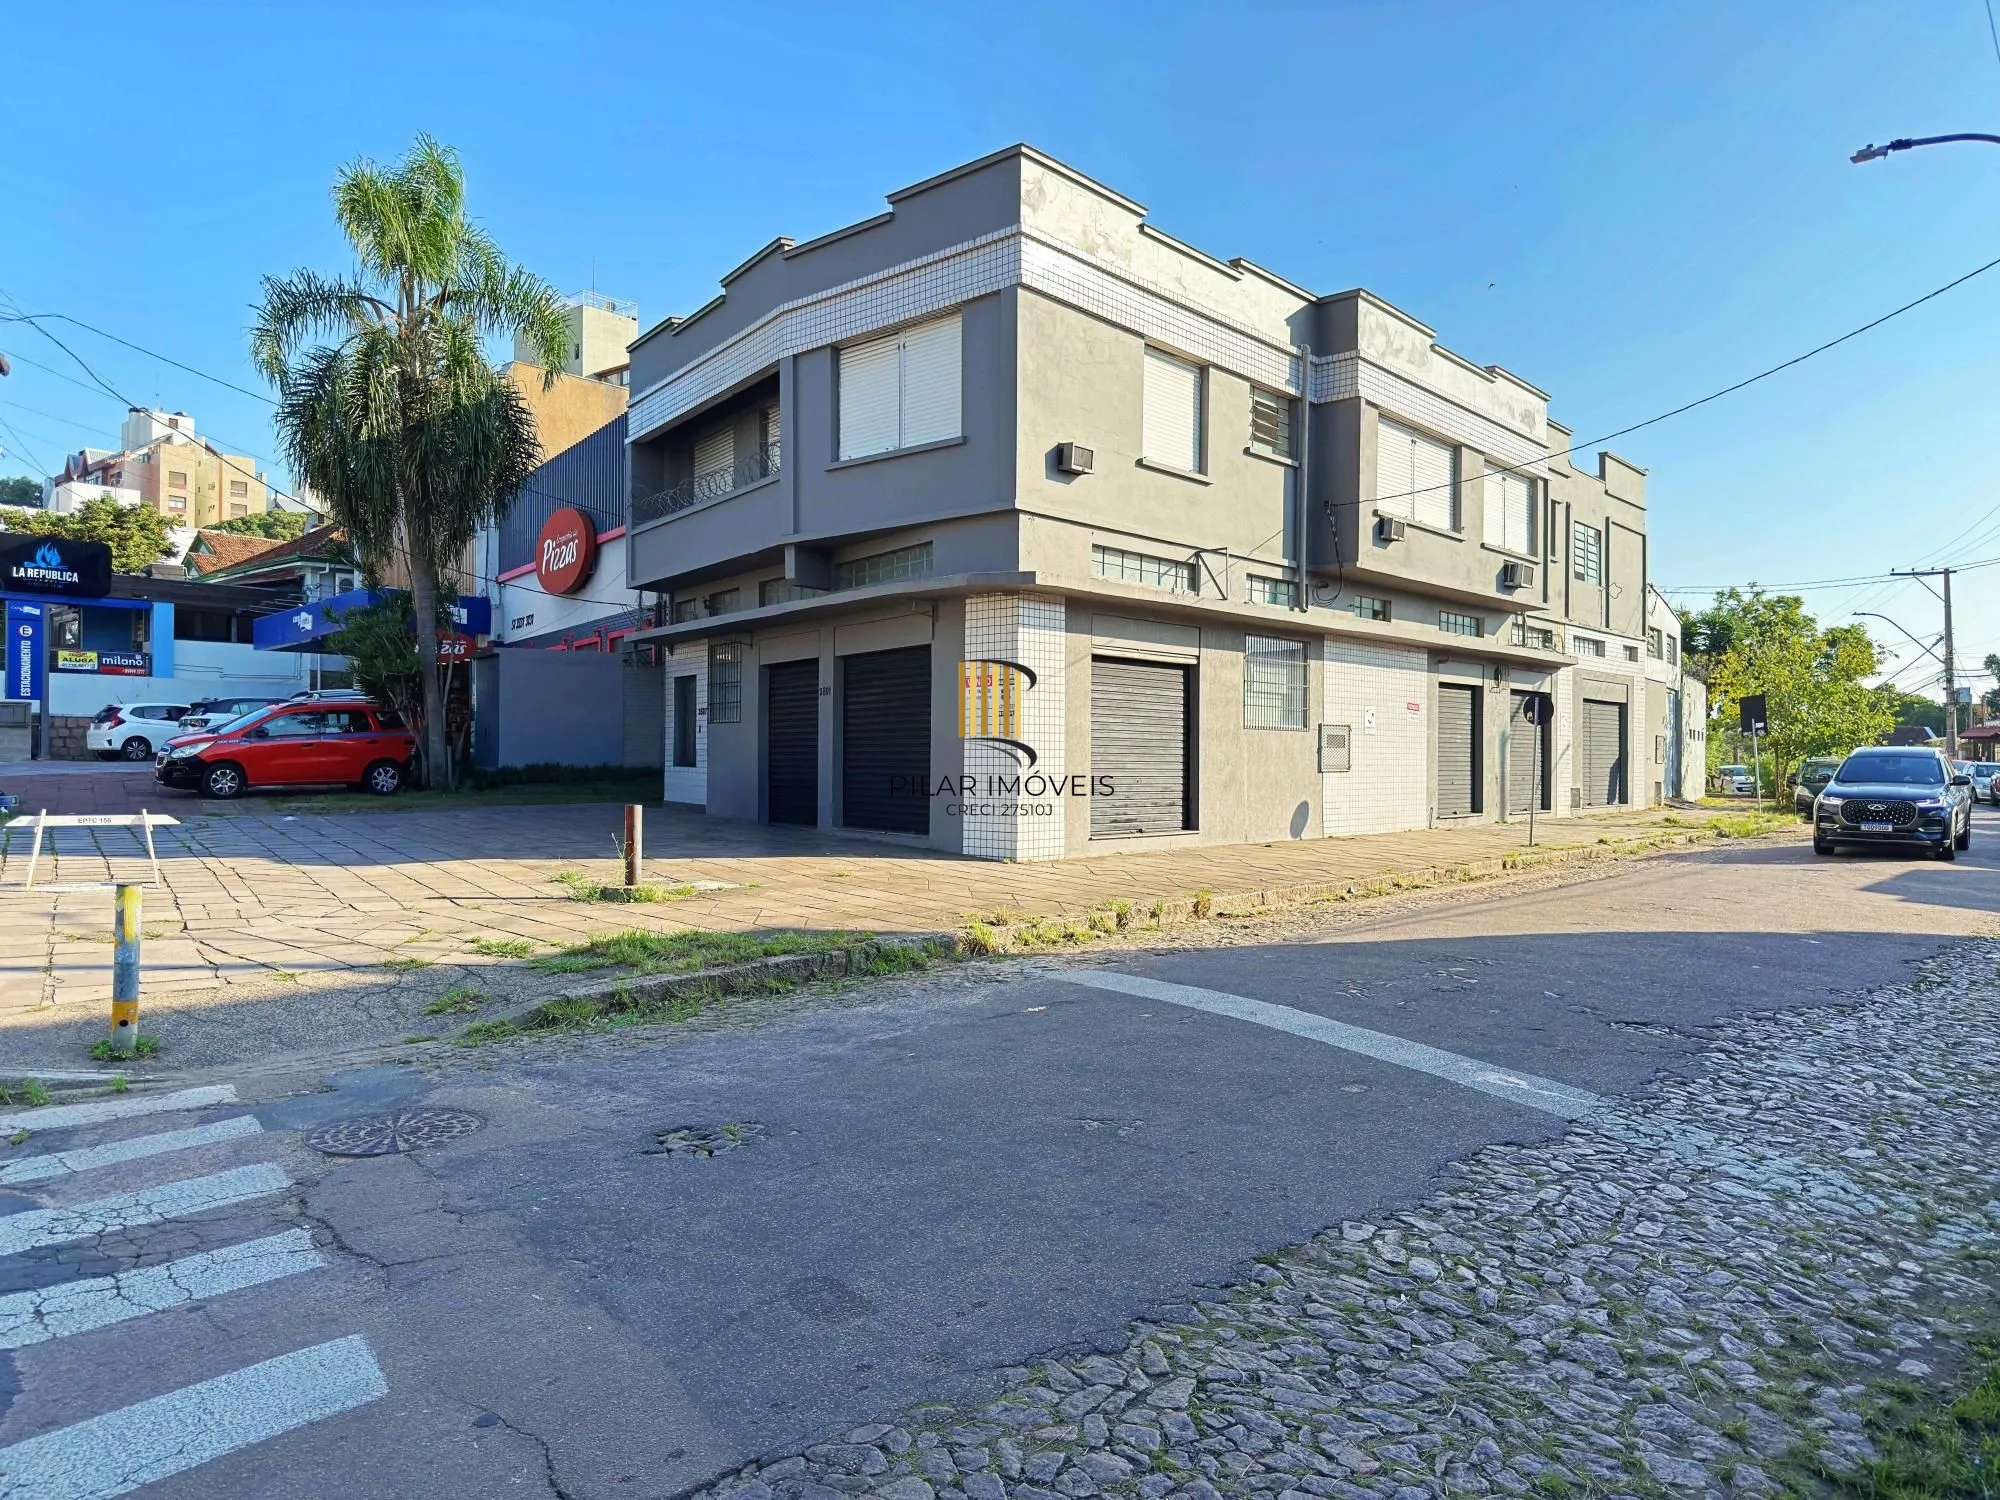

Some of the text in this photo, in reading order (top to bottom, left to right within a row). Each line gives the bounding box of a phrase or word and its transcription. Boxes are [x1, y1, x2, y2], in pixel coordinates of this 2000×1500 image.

[542, 539, 578, 576] Pizzas
[12, 566, 79, 583] LA REPUBLICA
[20, 640, 31, 697] ESTACIONAMENTO
[102, 655, 143, 666] milano
